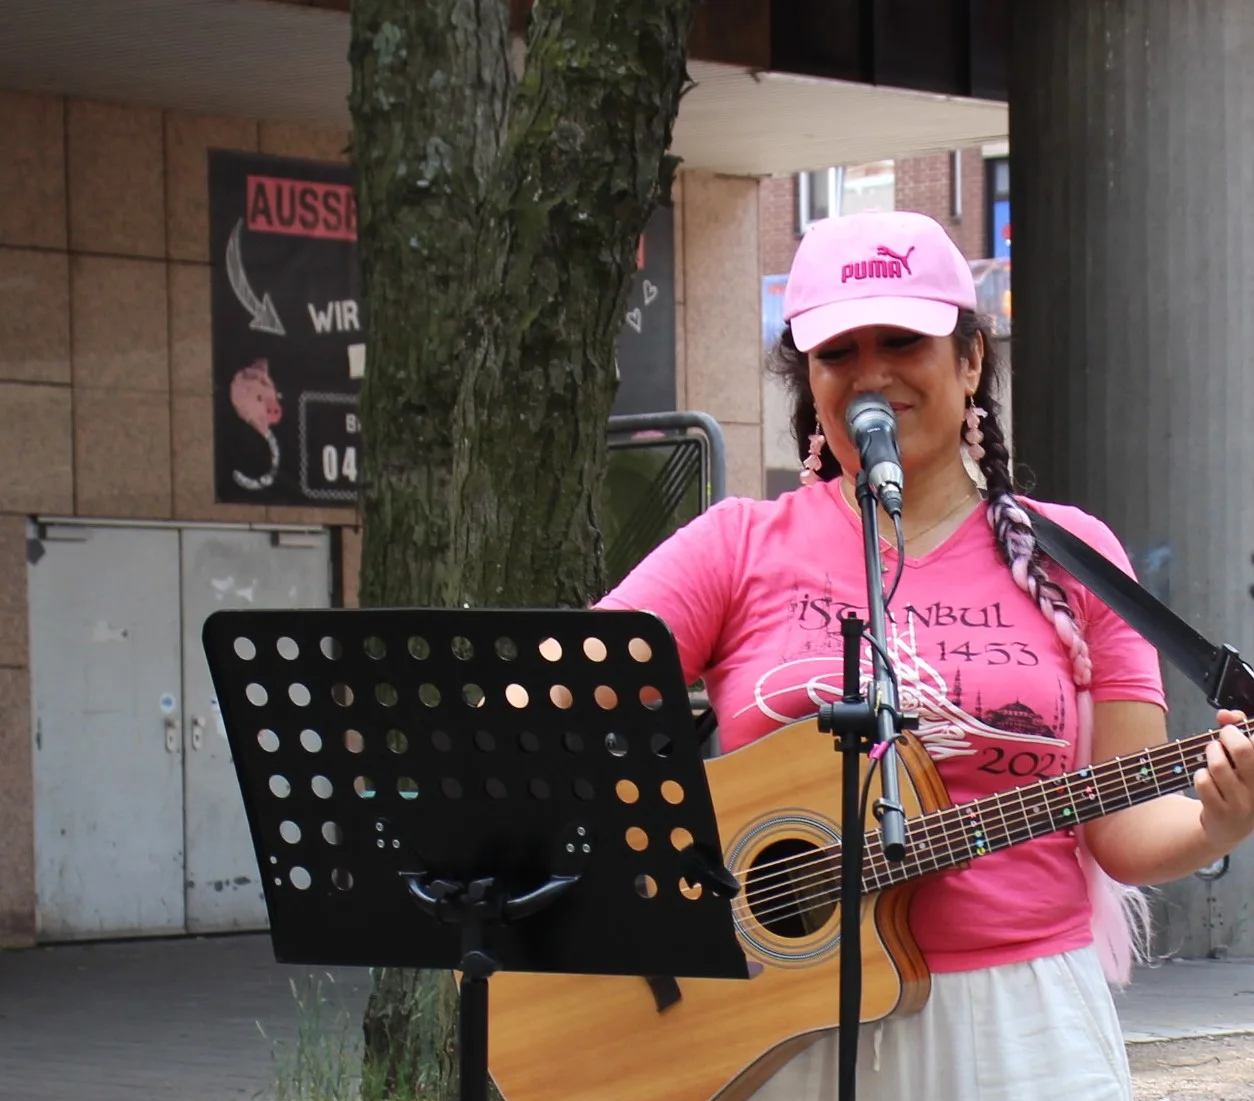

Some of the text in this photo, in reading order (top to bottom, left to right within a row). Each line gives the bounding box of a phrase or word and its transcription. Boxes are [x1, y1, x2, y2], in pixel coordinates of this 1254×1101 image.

[841, 259, 902, 284] PUMA
[308, 299, 361, 334] WIR
[936, 639, 1040, 666] 1453
